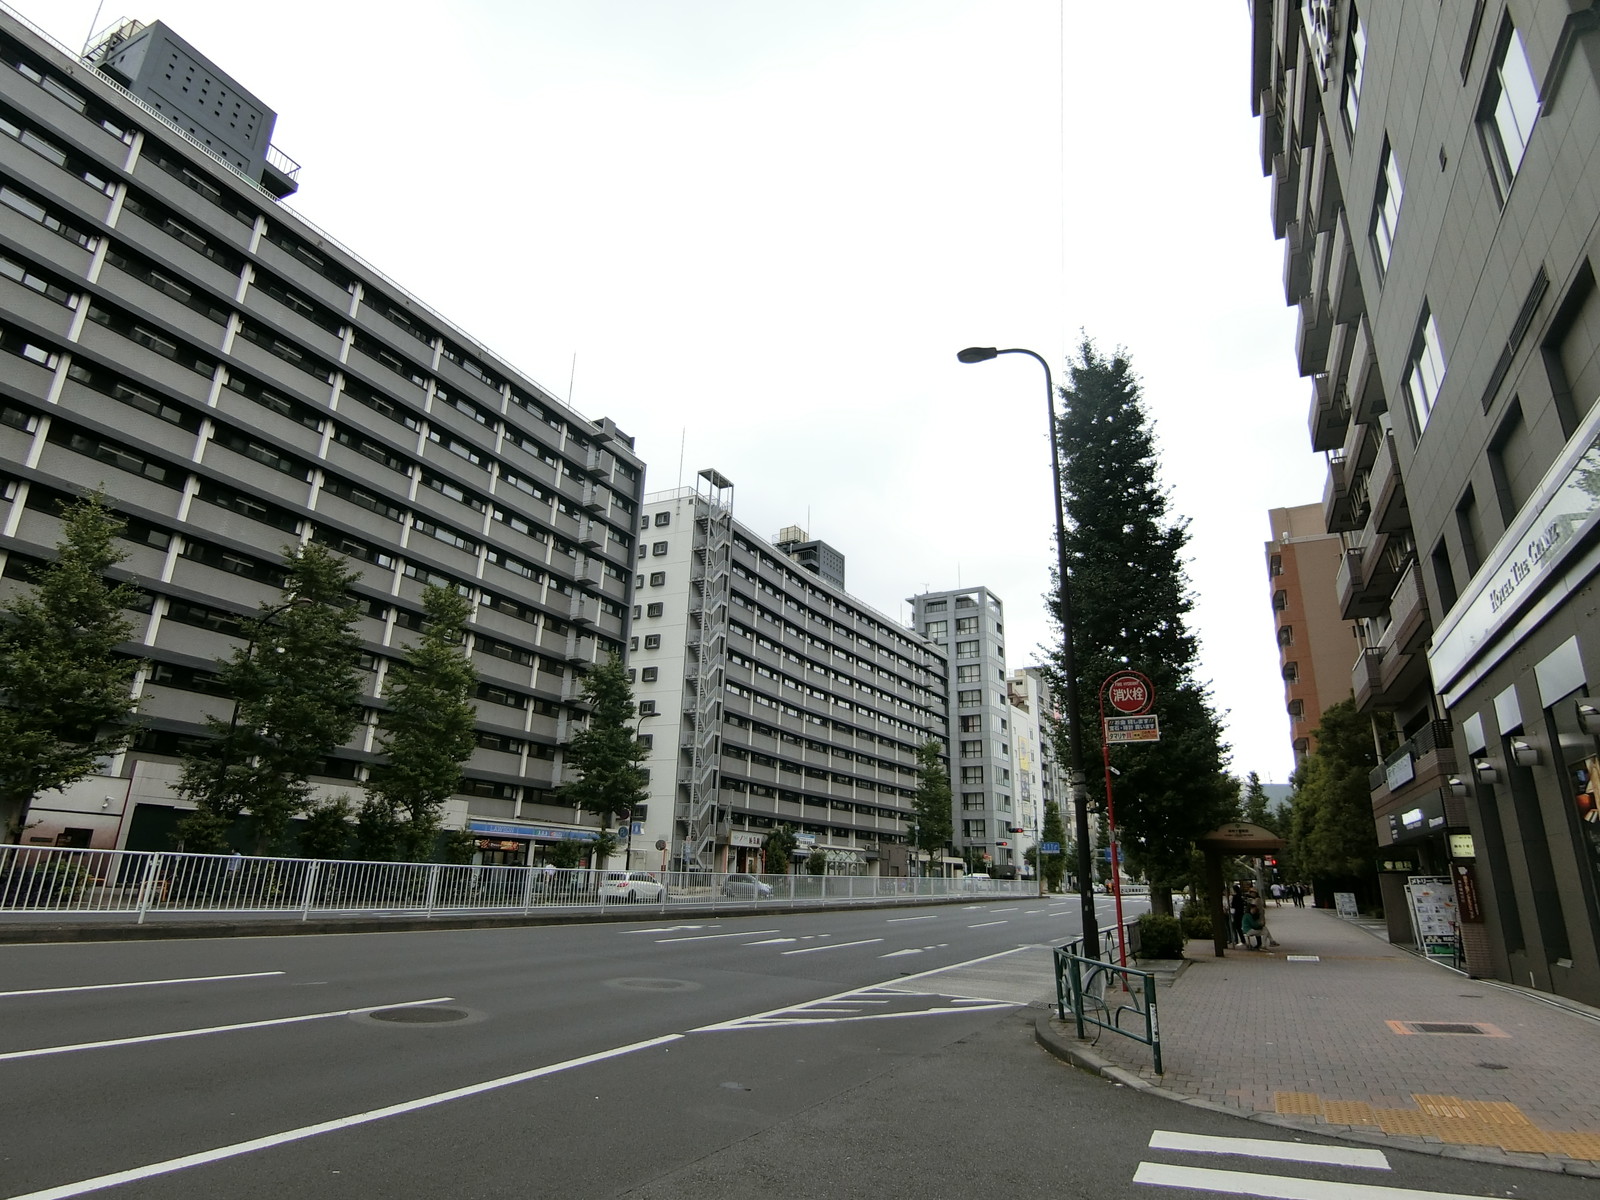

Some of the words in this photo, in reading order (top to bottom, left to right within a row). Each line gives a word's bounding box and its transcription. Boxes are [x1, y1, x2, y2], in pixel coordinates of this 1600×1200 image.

[1112, 687, 1144, 702] 消火栓
[489, 825, 515, 833] LAWSON
